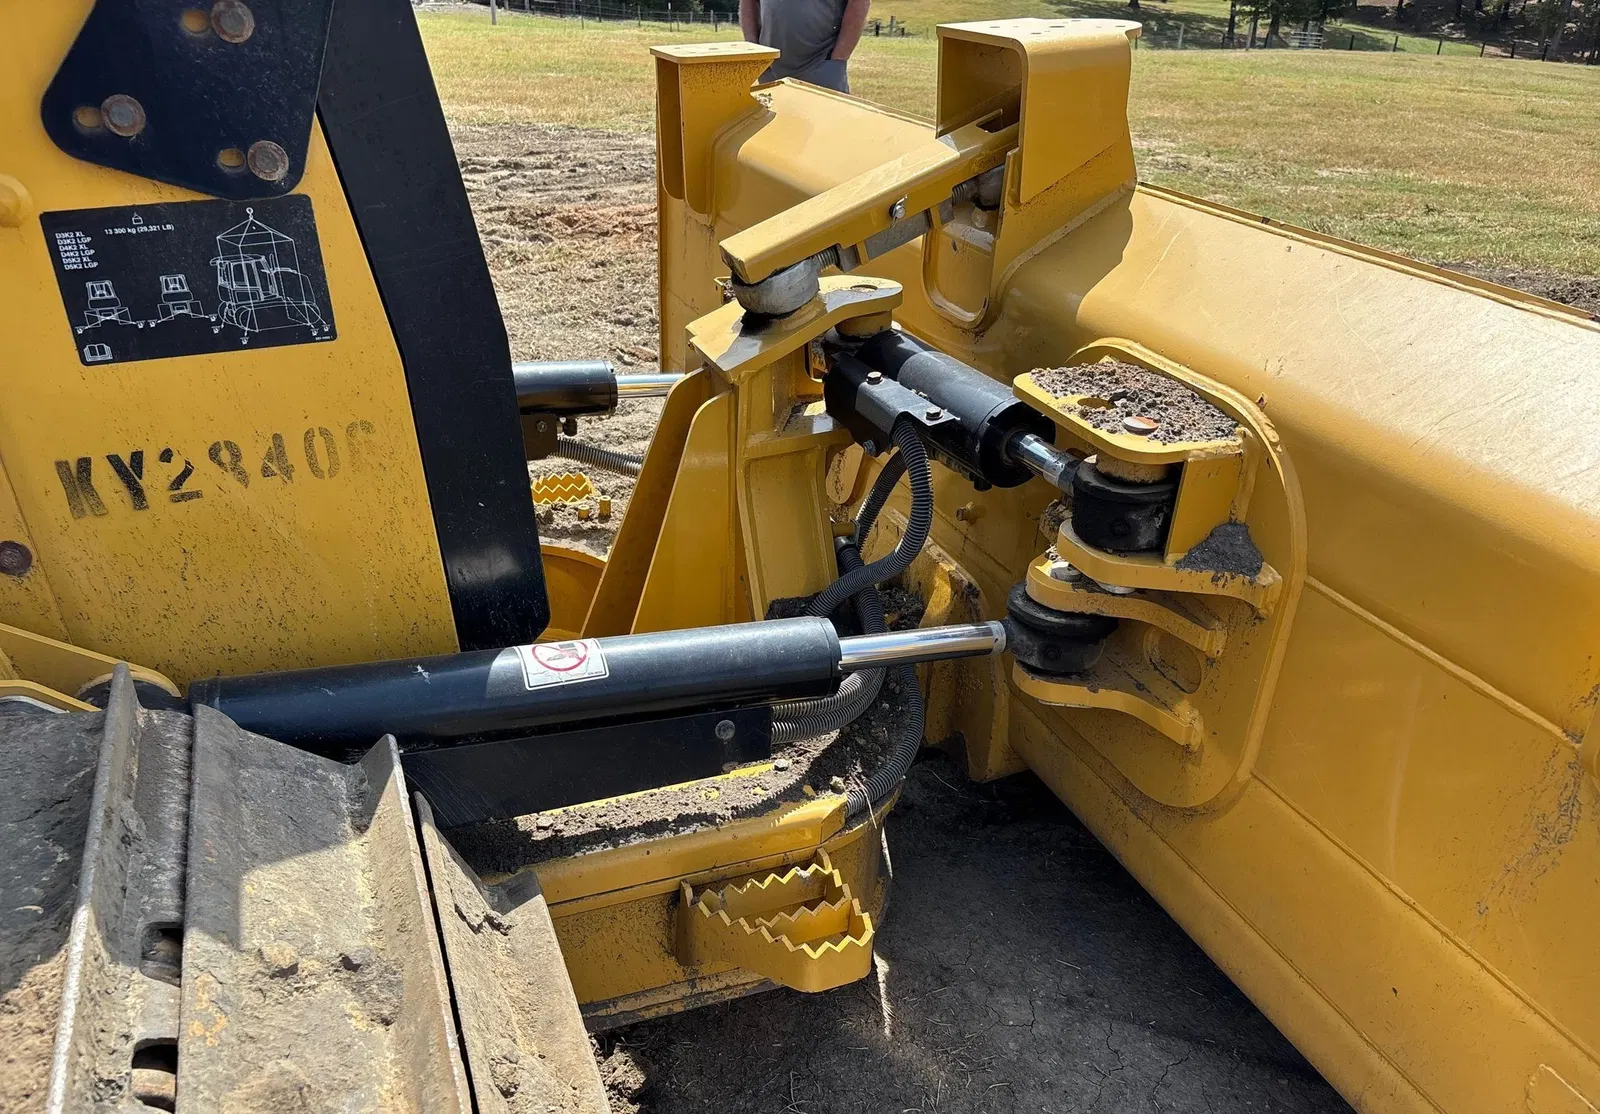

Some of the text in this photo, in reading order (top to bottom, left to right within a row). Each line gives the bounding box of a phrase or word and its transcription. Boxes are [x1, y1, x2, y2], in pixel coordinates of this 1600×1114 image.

[55, 231, 74, 239] D3K2
[127, 227, 137, 235] kg
[57, 237, 76, 245] D3K2
[62, 256, 81, 264] D5K2
[84, 261, 99, 269] LGP
